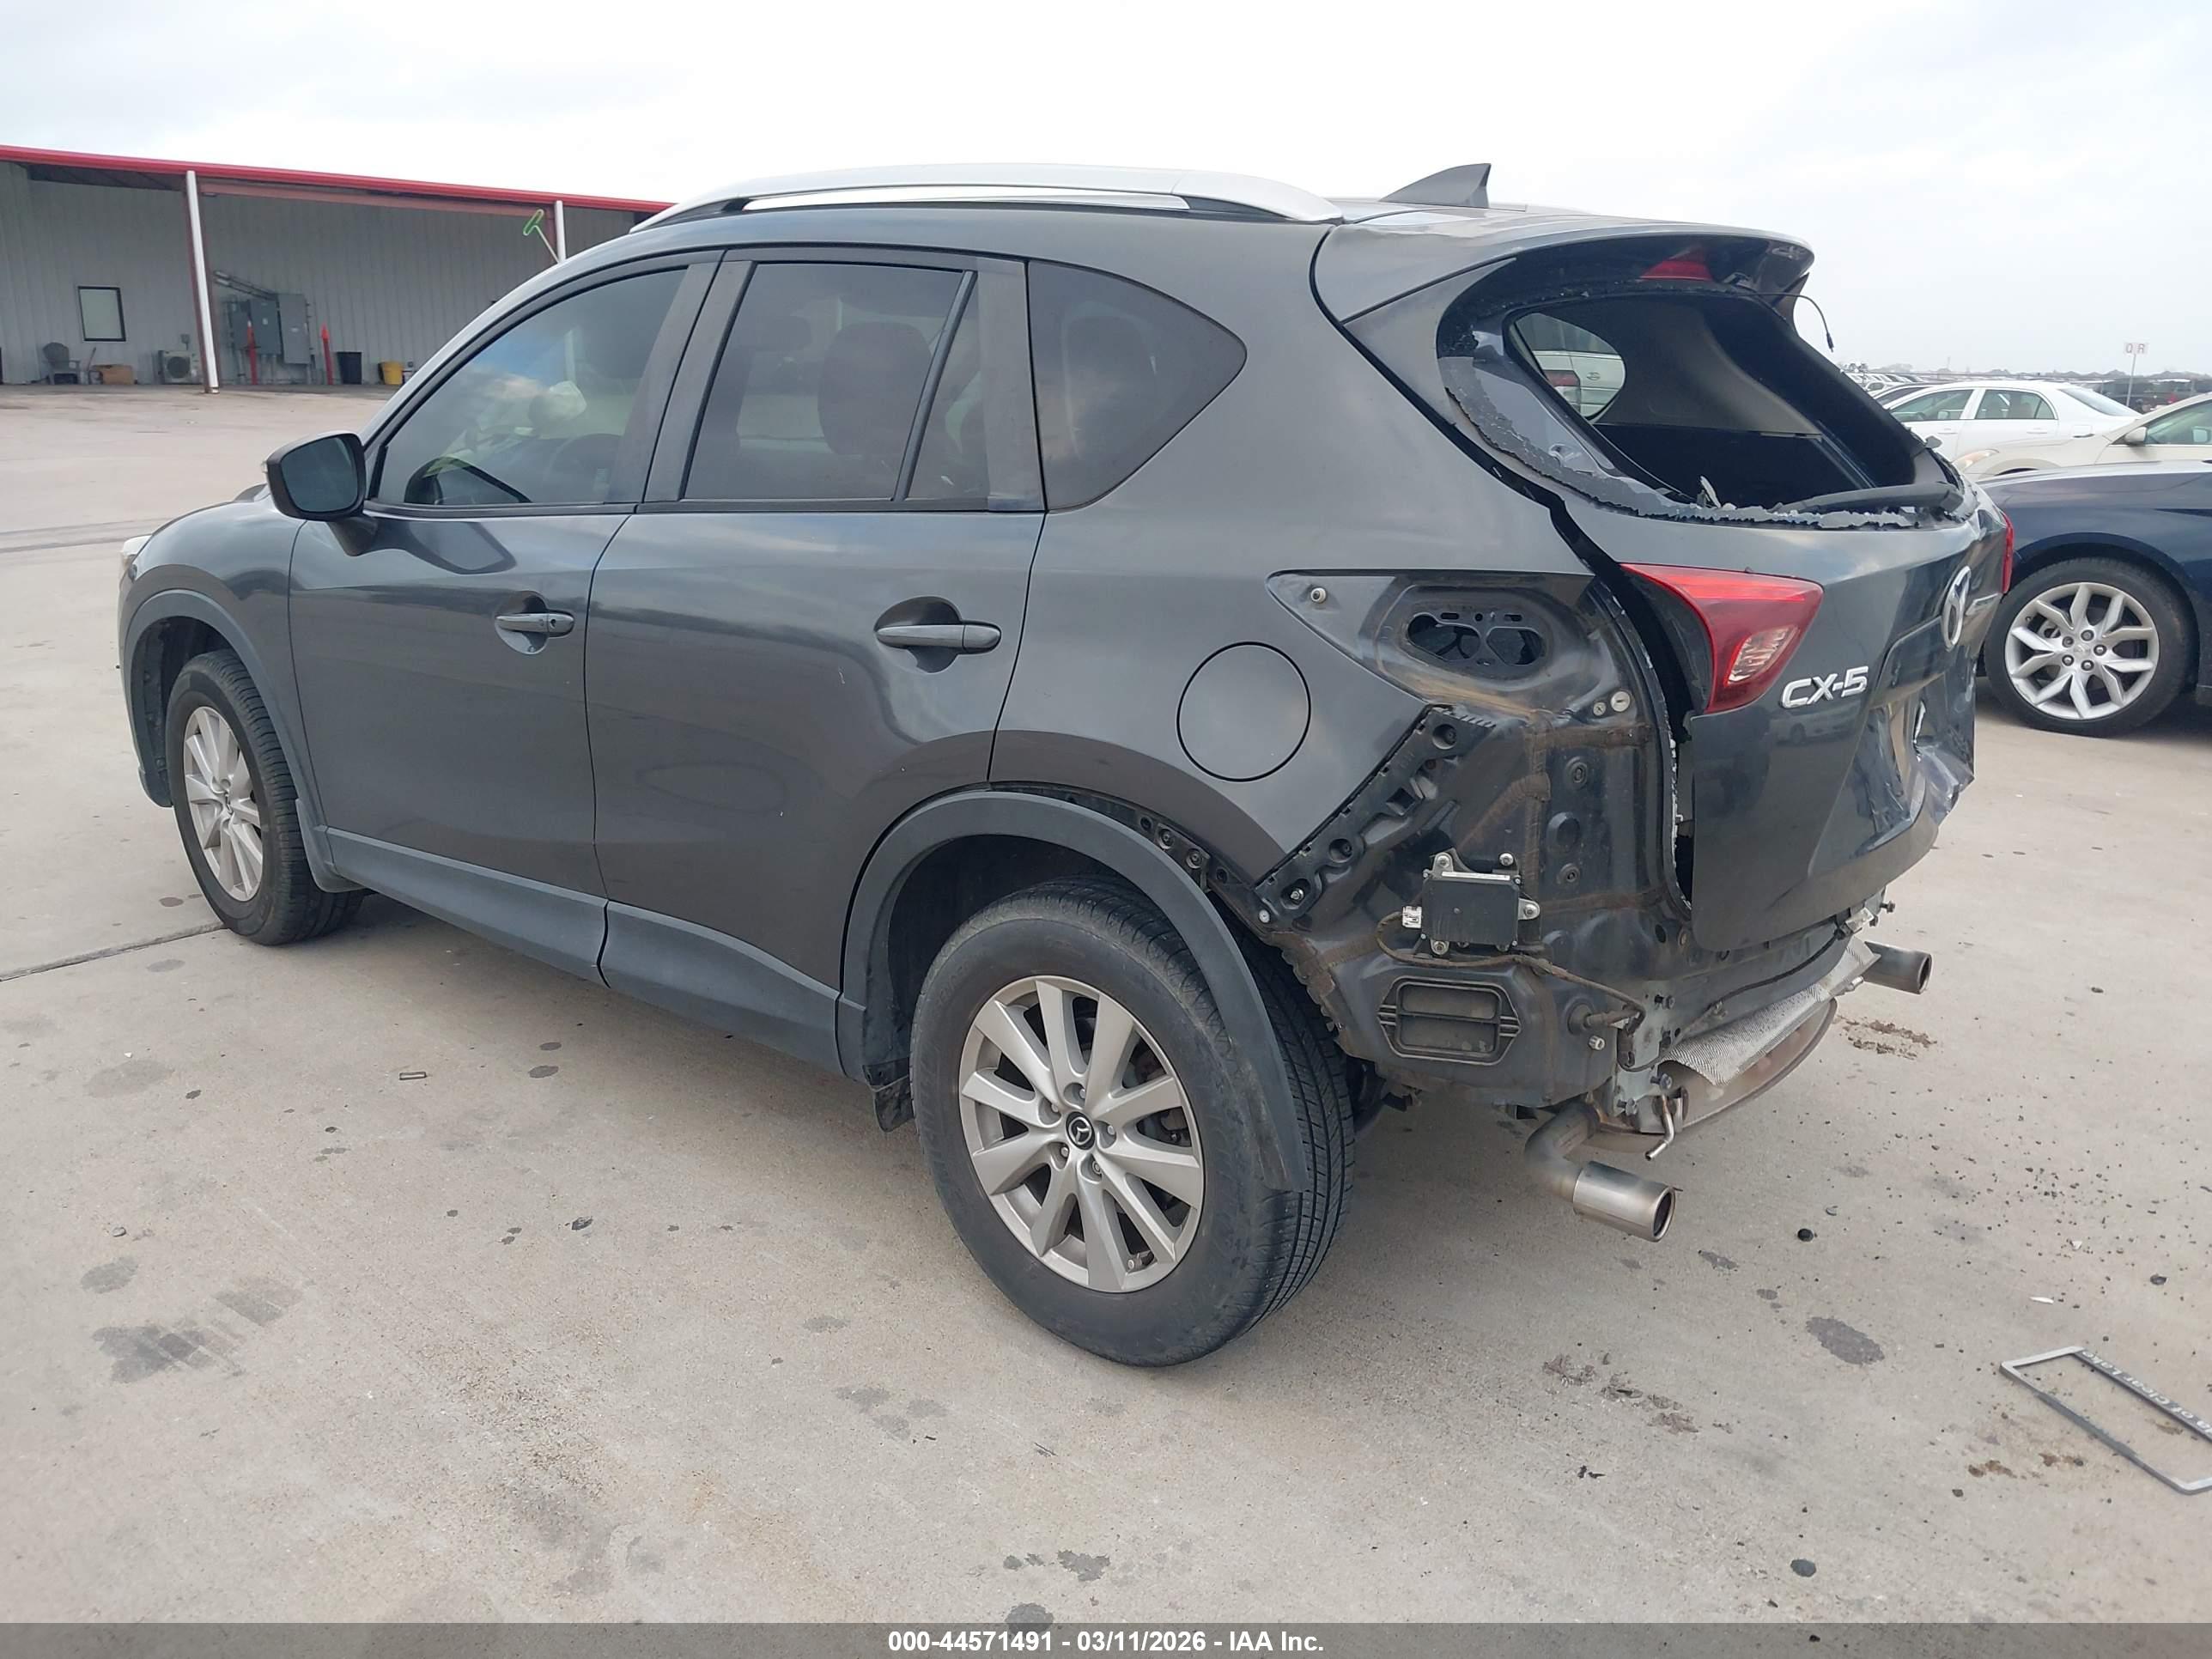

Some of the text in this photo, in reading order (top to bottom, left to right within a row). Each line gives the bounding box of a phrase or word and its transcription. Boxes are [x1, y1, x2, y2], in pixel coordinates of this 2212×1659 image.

[1782, 665, 1869, 708] CX-5
[2082, 1351, 2194, 1419] of Clear Lake
